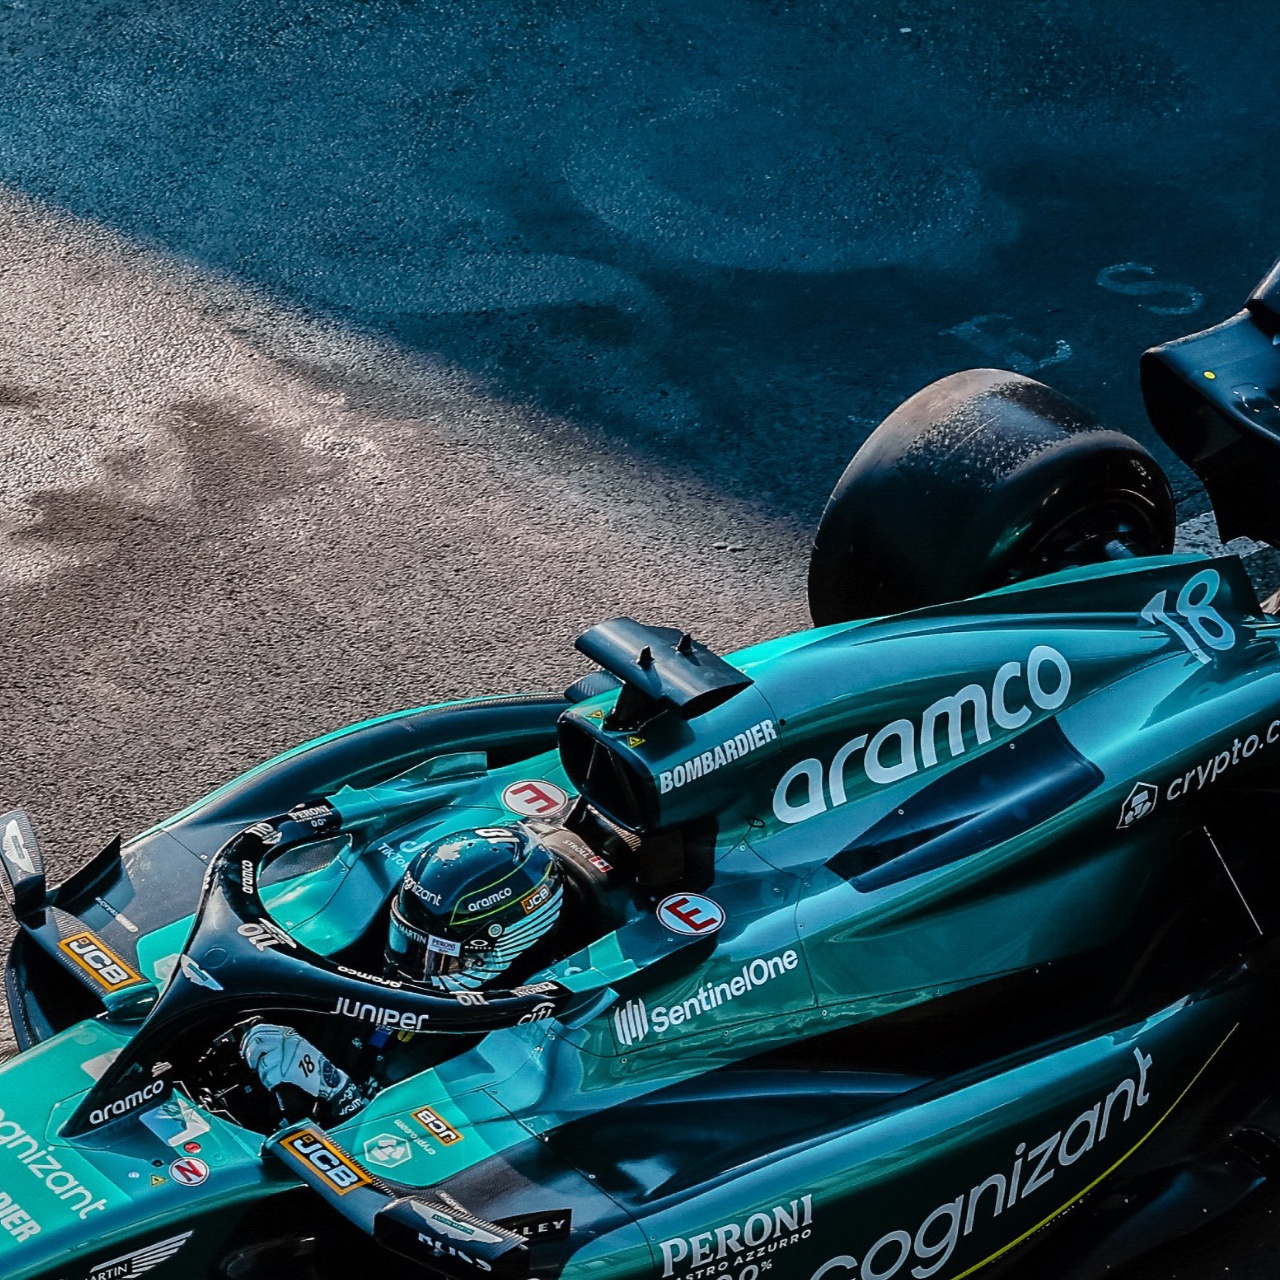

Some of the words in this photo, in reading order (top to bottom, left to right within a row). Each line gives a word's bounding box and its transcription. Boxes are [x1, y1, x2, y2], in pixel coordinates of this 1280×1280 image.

[1139, 569, 1237, 665] 18
[772, 646, 1071, 824] aramco
[659, 720, 777, 795] BOMBARDIER
[1167, 720, 1280, 800] crypto.c
[288, 805, 330, 820] PERONI
[510, 783, 559, 813] E
[563, 840, 590, 858] STROLL
[242, 860, 253, 894] aramco
[404, 871, 441, 906] gnizant
[468, 887, 512, 912] aramco
[526, 888, 550, 910] JCB
[665, 899, 716, 932] E
[237, 923, 278, 951] 110
[400, 924, 427, 944] MARTIN
[69, 938, 128, 985] JCB
[338, 966, 402, 988] aramco
[652, 949, 798, 1031] SentinelOne
[517, 1003, 554, 1026] citi
[298, 1054, 315, 1078] 18
[89, 1079, 164, 1125] aramco
[394, 1119, 436, 1155] crypto.com
[417, 1110, 457, 1141] JCB
[174, 1160, 204, 1182] N
[293, 1136, 358, 1188] JCB
[514, 1220, 565, 1236] LEY
[659, 1194, 813, 1278] PERONI
[733, 1228, 812, 1267] AZZURRO
